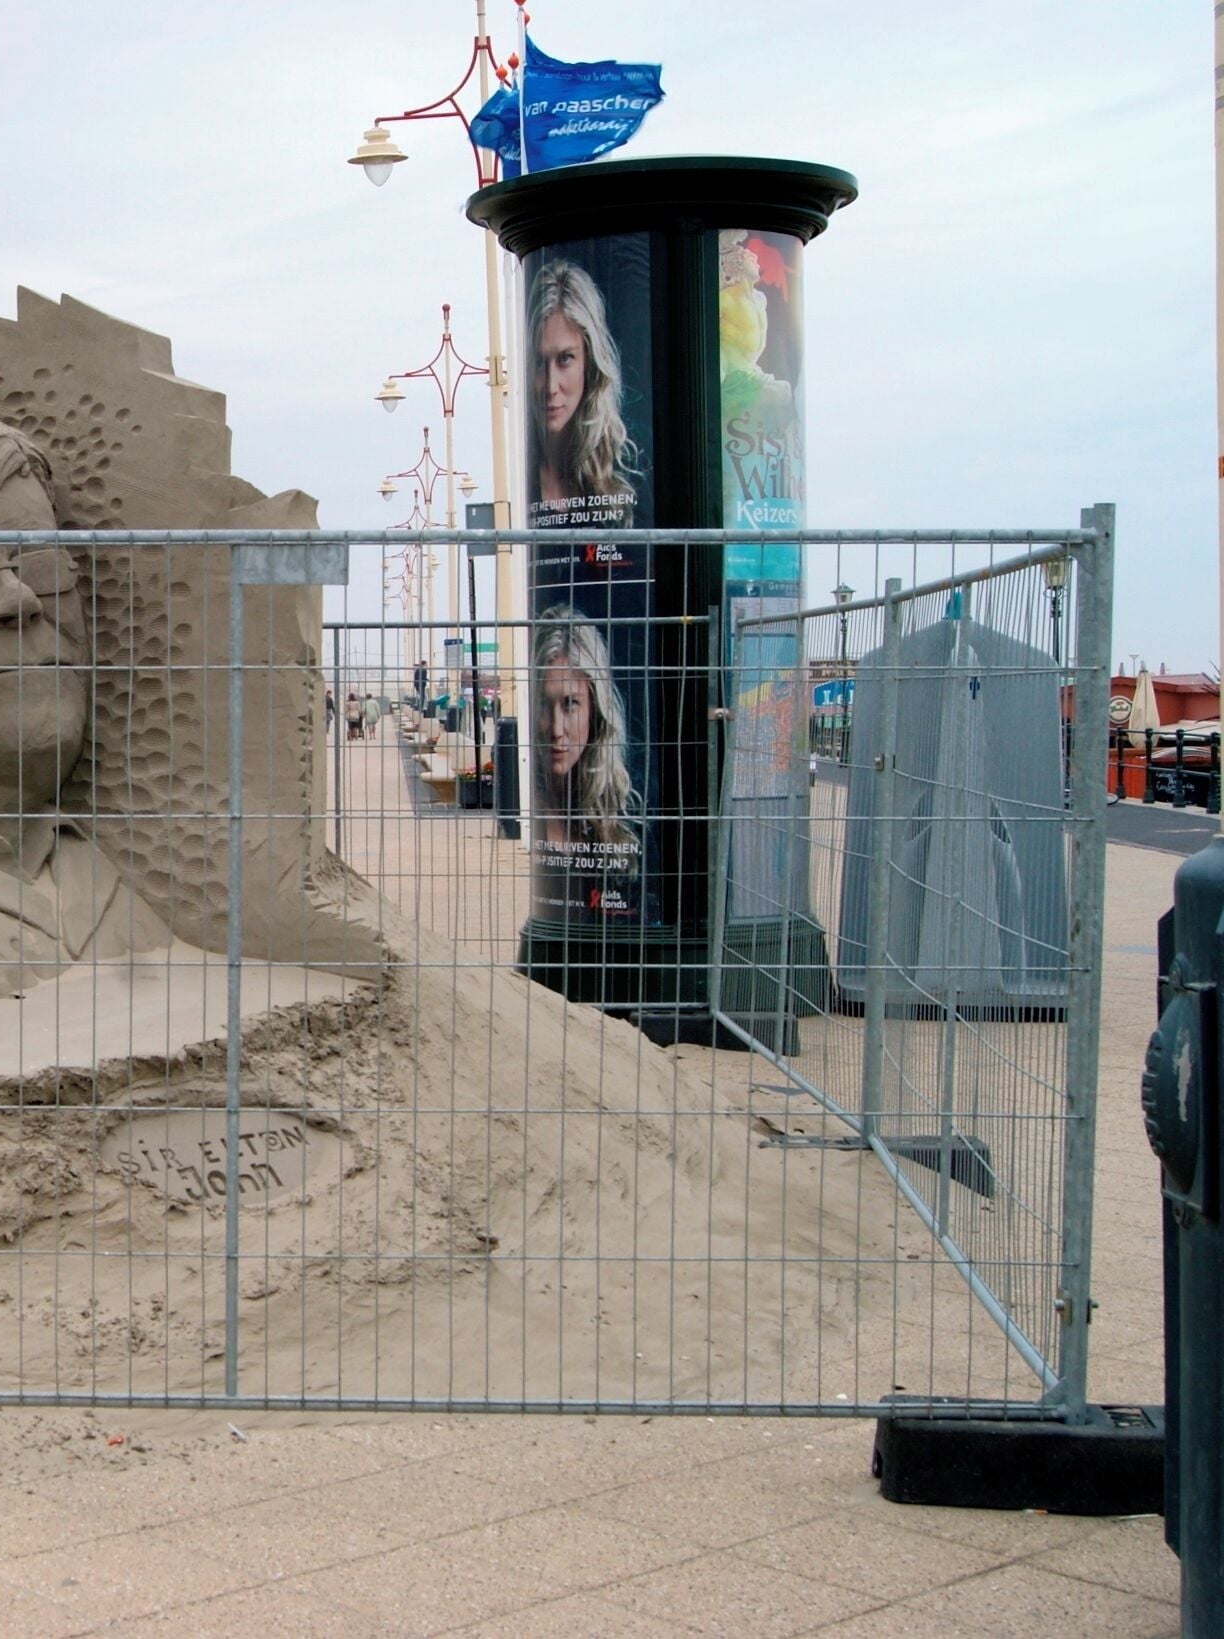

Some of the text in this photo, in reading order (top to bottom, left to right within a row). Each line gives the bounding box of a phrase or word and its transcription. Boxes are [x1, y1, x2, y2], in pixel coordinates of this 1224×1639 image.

[525, 101, 549, 117] van
[551, 497, 585, 510] DURVEN
[587, 494, 638, 507] ZOENEN,
[570, 512, 591, 524] ZOU
[592, 509, 624, 522] ZIJN?
[592, 843, 642, 856] ZOENEN,
[574, 858, 595, 869] ZOU
[597, 859, 628, 869] ZJN?
